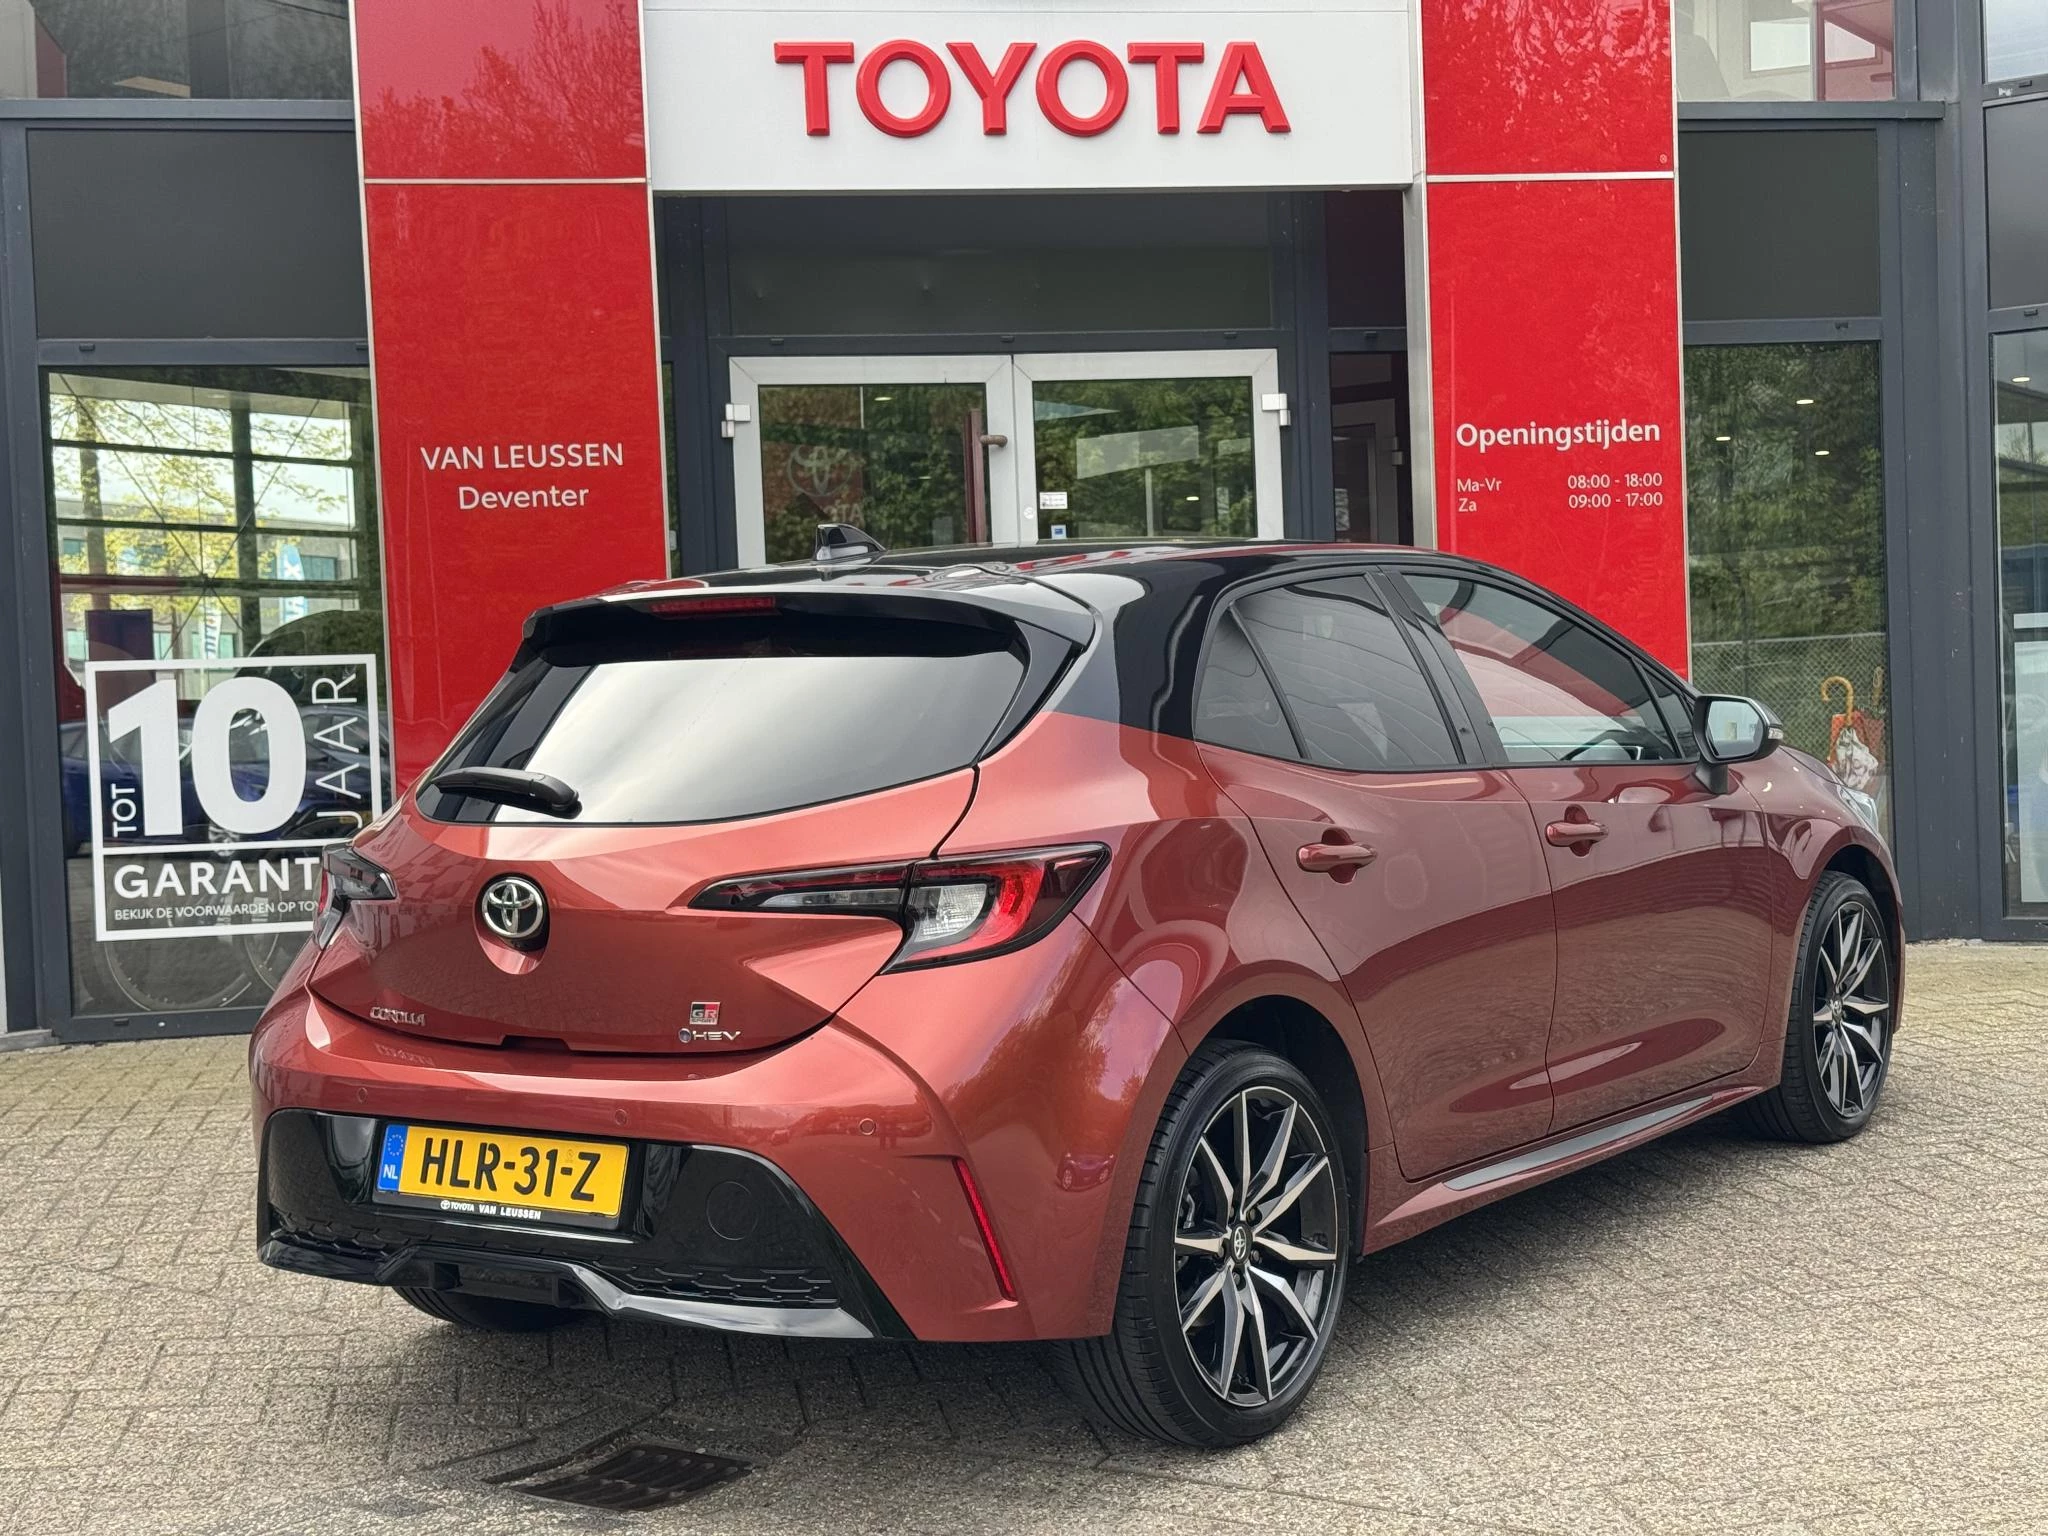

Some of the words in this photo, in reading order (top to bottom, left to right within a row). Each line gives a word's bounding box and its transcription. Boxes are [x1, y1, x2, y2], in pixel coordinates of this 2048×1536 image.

[774, 39, 1292, 138] TOYOTA
[1456, 418, 1661, 453] Openingstijden
[420, 446, 484, 470] VAN
[493, 443, 624, 469] LEUSSEN
[1456, 477, 1502, 492] Ma-Vr
[1567, 474, 1611, 489] 08:00
[1624, 472, 1663, 488] 18:00
[458, 486, 589, 509] Deventer
[1458, 498, 1477, 512] Za
[1568, 493, 1612, 509] 09:00
[1624, 492, 1664, 507] 17:00
[108, 676, 307, 836] 10
[311, 673, 364, 829] JAAR
[111, 783, 137, 838] TOT
[114, 908, 153, 920] BEKIJK
[156, 907, 172, 919] DE
[174, 902, 275, 918] VOORWAARDEN
[277, 901, 296, 912] OP
[369, 1006, 426, 1027] COROLLA
[692, 1009, 717, 1018] GR
[692, 1030, 741, 1040] HEV
[383, 1163, 398, 1180] NL
[420, 1137, 601, 1202] HLR-31-Z
[450, 1201, 475, 1212] TOYOTA
[479, 1203, 497, 1215] VAN
[500, 1206, 542, 1220] LEUSSEN
